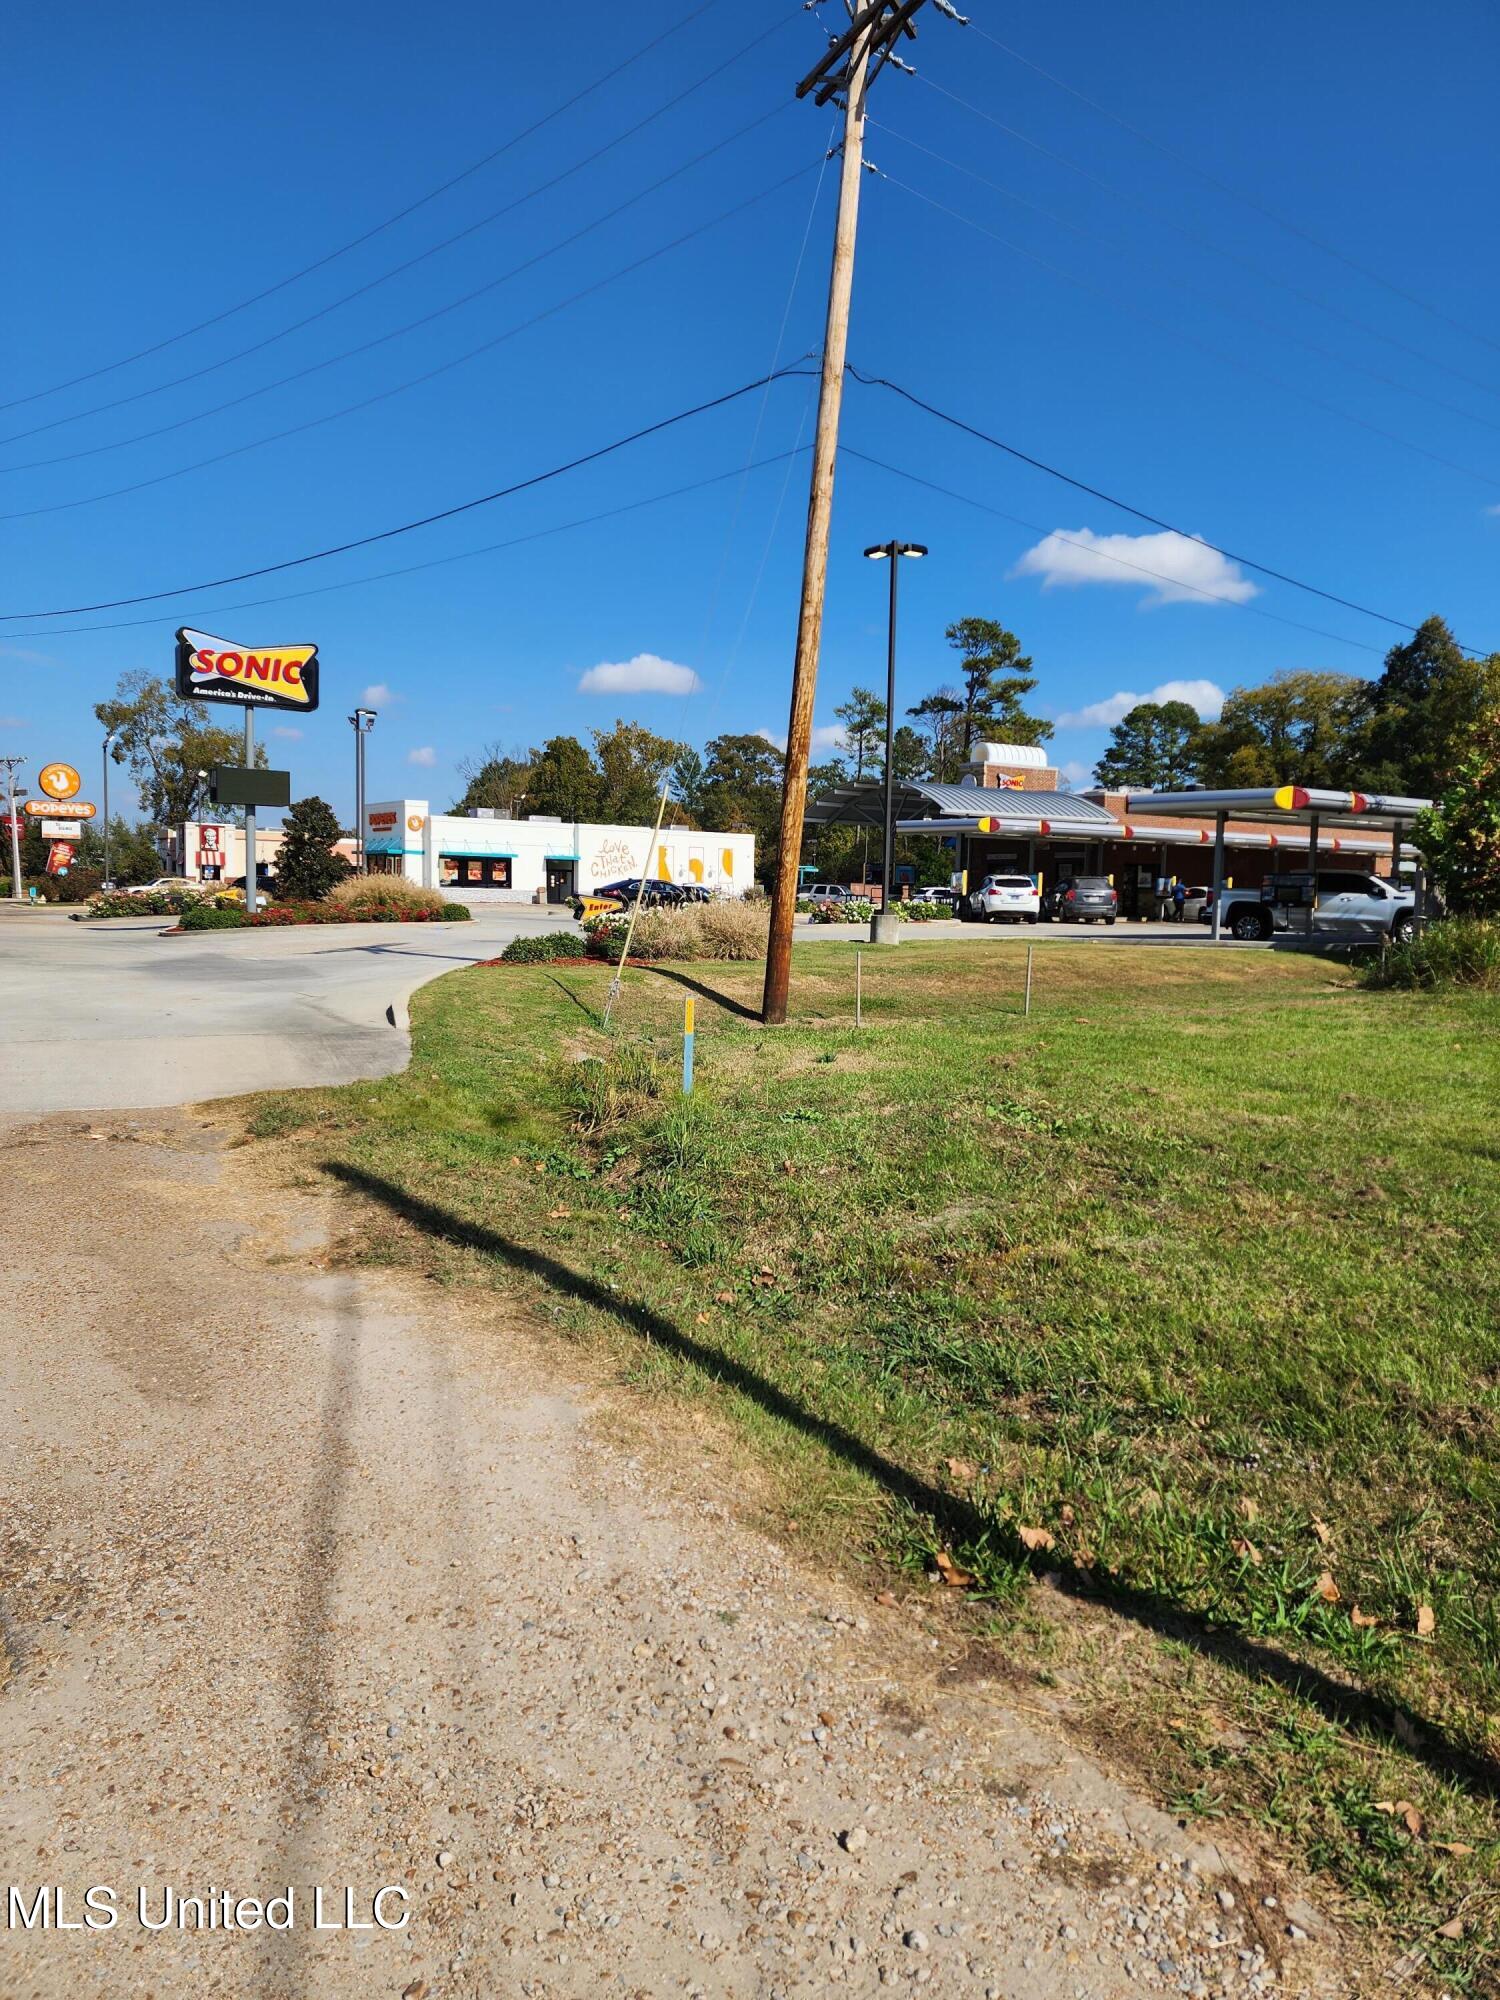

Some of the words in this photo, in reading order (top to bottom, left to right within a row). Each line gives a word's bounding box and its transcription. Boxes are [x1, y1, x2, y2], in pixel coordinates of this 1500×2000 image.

[194, 649, 303, 685] SONIC
[192, 686, 237, 699] America's
[1002, 779, 1023, 787] SONIC
[588, 903, 613, 912] Enter
